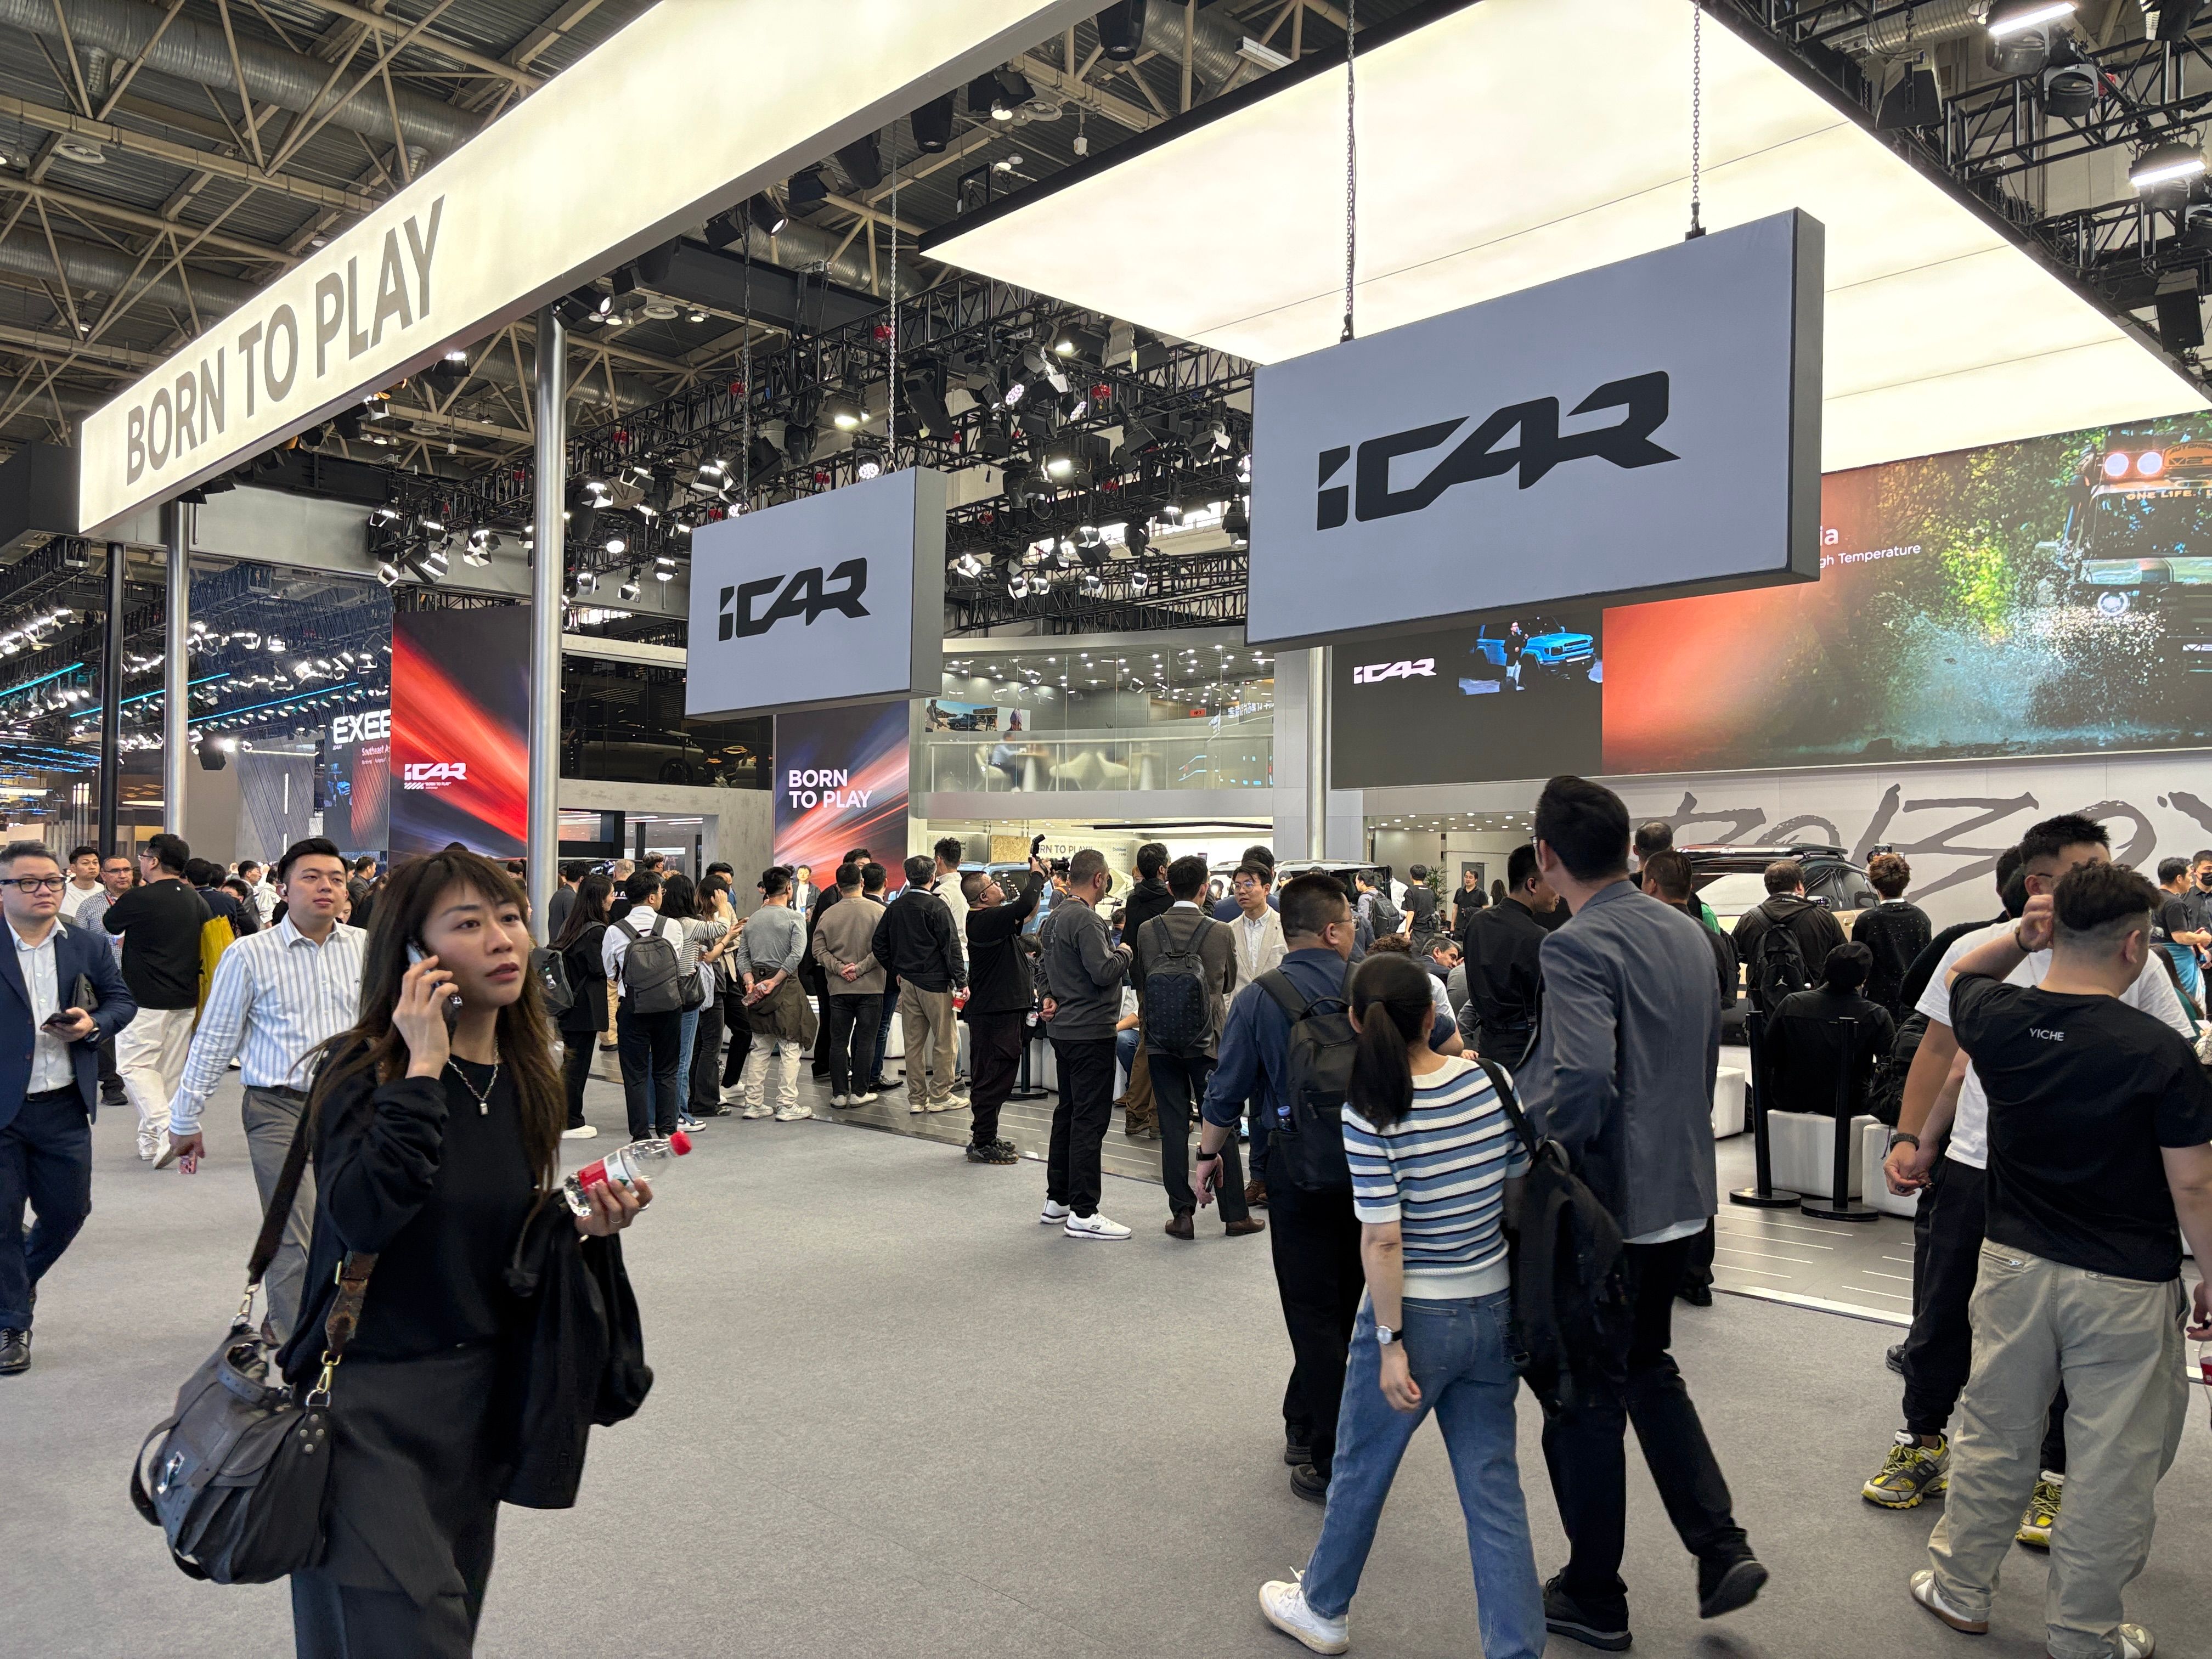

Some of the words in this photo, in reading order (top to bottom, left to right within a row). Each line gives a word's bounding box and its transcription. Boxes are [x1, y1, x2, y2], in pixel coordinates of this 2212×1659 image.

[127, 346, 225, 487] BORN
[238, 304, 298, 418] TO
[315, 194, 445, 378] PLAY
[2126, 492, 2156, 500] ONE
[1838, 544, 1921, 565] Temperature
[788, 769, 848, 788] BORN
[788, 790, 817, 809] TO
[823, 790, 872, 809] PLAY
[1054, 845, 1066, 854] TO
[2029, 1028, 2064, 1042] YICHE
